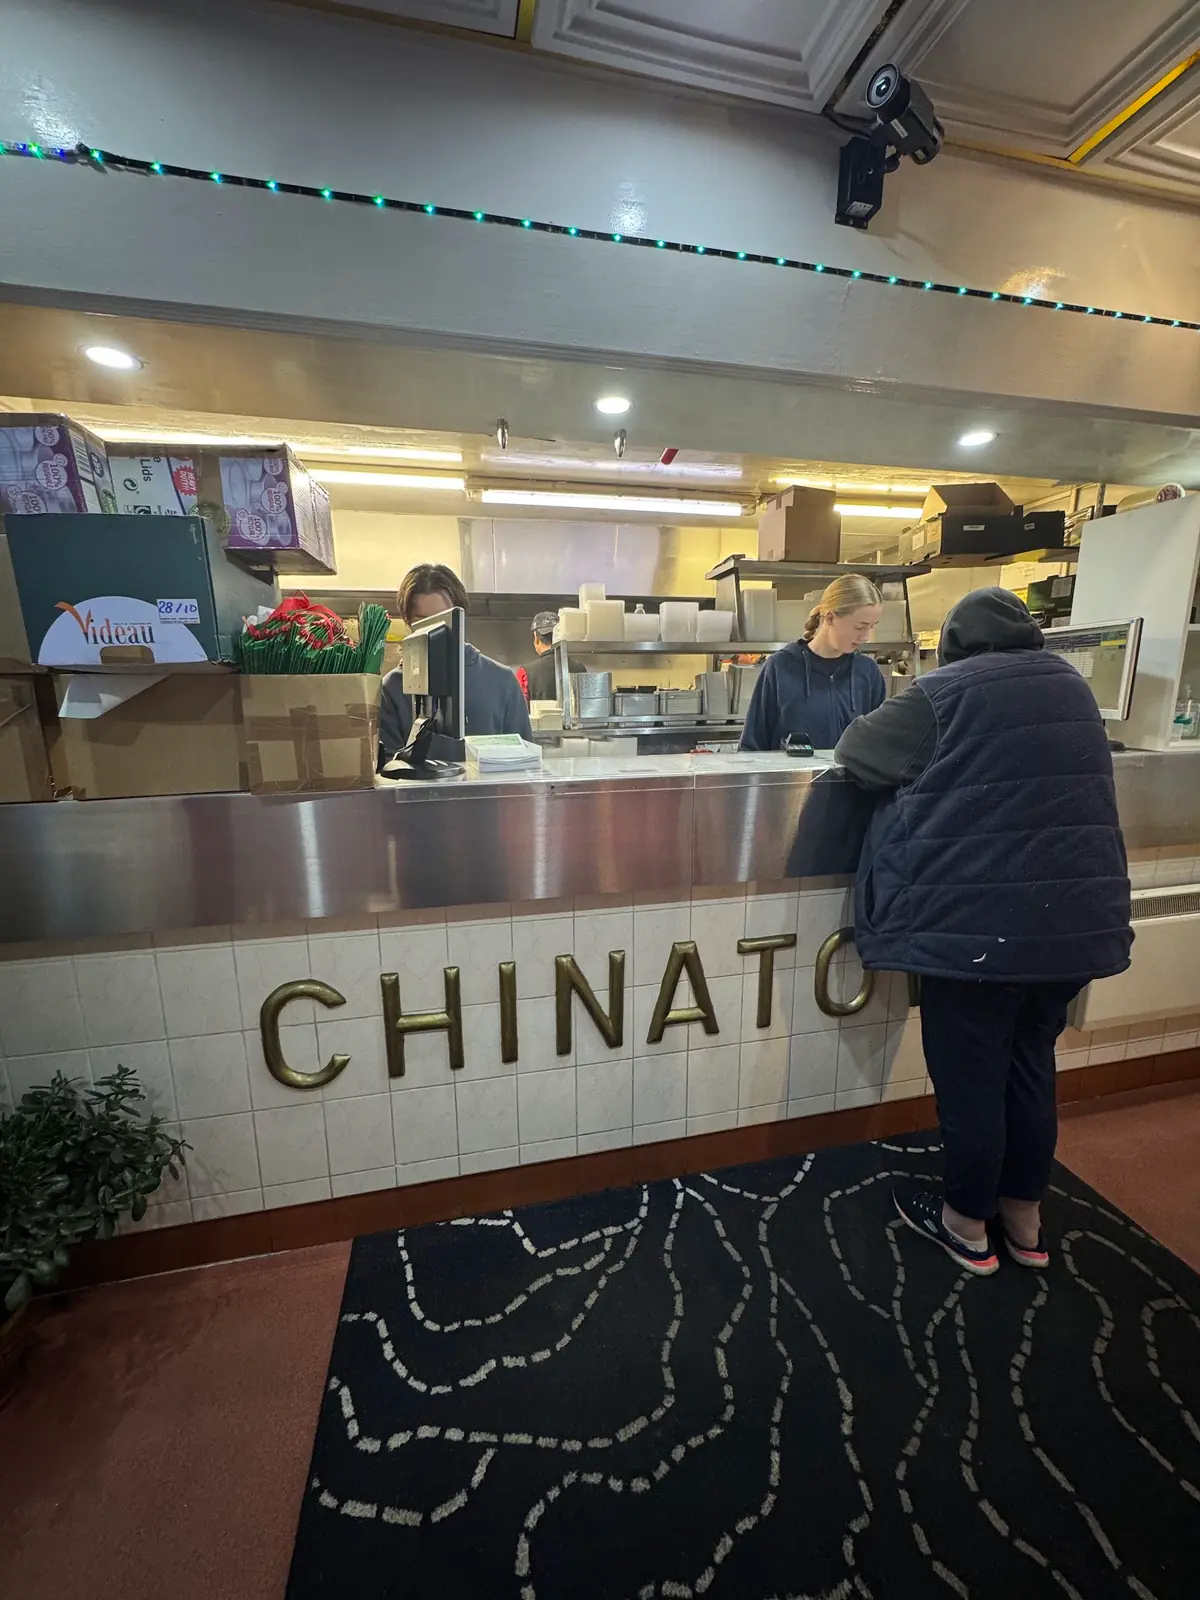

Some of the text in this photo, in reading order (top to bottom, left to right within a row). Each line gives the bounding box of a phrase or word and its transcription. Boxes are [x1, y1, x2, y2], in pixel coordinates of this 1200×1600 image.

[50, 463, 62, 488] 100%
[140, 459, 153, 482] Lids
[187, 471, 197, 492] HEAVY
[29, 495, 42, 514] 100
[273, 490, 283, 512] 100%
[253, 517, 263, 539] 100%
[53, 601, 156, 645] Videau
[259, 926, 921, 1090] CHINATO
